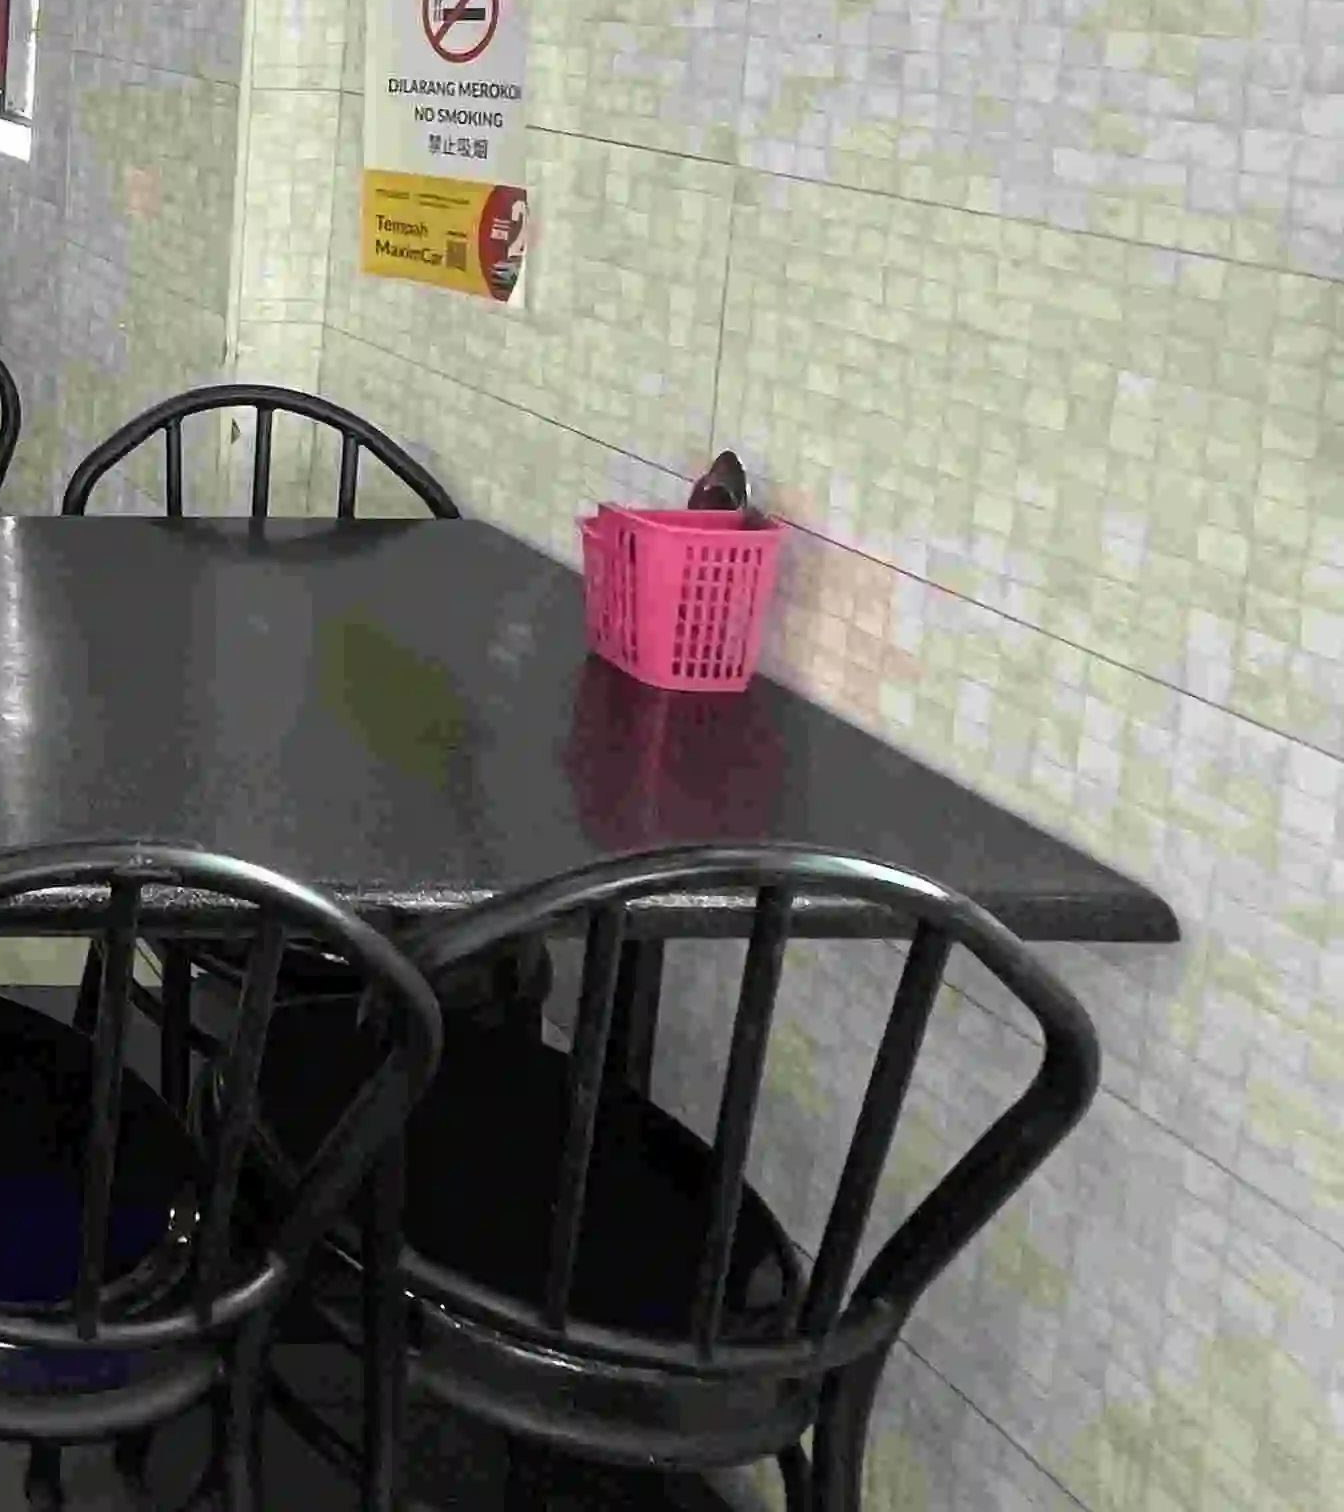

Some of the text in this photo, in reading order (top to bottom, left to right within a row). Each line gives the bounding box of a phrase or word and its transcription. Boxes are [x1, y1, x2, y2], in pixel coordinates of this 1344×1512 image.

[388, 78, 456, 96] DILARANG
[414, 106, 503, 128] NO SMOKING
[375, 215, 428, 238] Tempah
